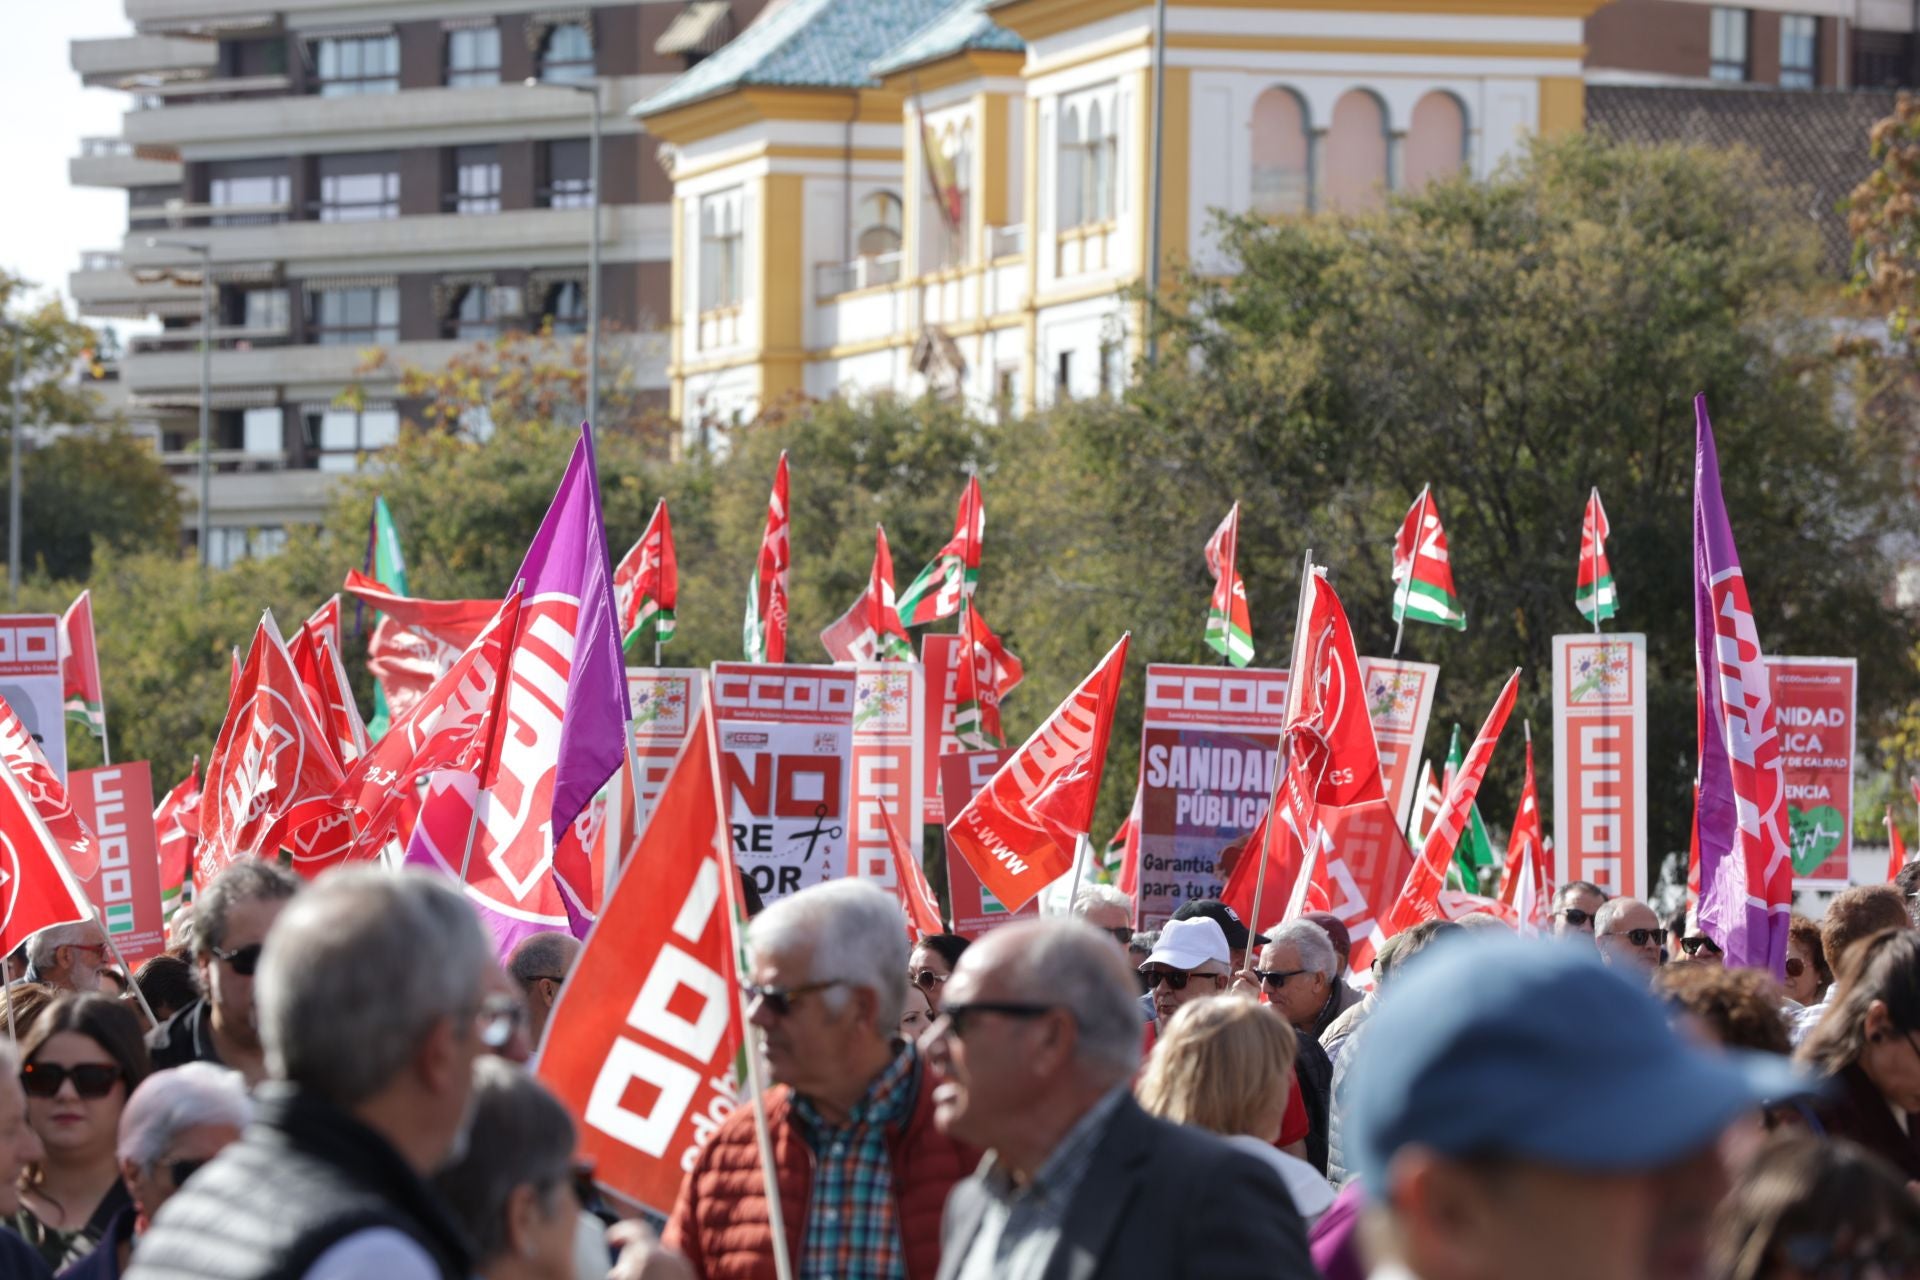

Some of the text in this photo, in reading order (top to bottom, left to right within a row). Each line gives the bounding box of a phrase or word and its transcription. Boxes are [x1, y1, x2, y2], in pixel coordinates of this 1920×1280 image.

[715, 673, 856, 712] CCOO
[1145, 675, 1287, 714] CCOO
[1775, 706, 1845, 727] NIDAD
[1788, 757, 1801, 767] DE
[1804, 757, 1847, 768] CALIDAD
[719, 752, 841, 817] NO
[92, 769, 133, 902] CCOO
[739, 865, 802, 895] OR
[1143, 881, 1181, 901] para
